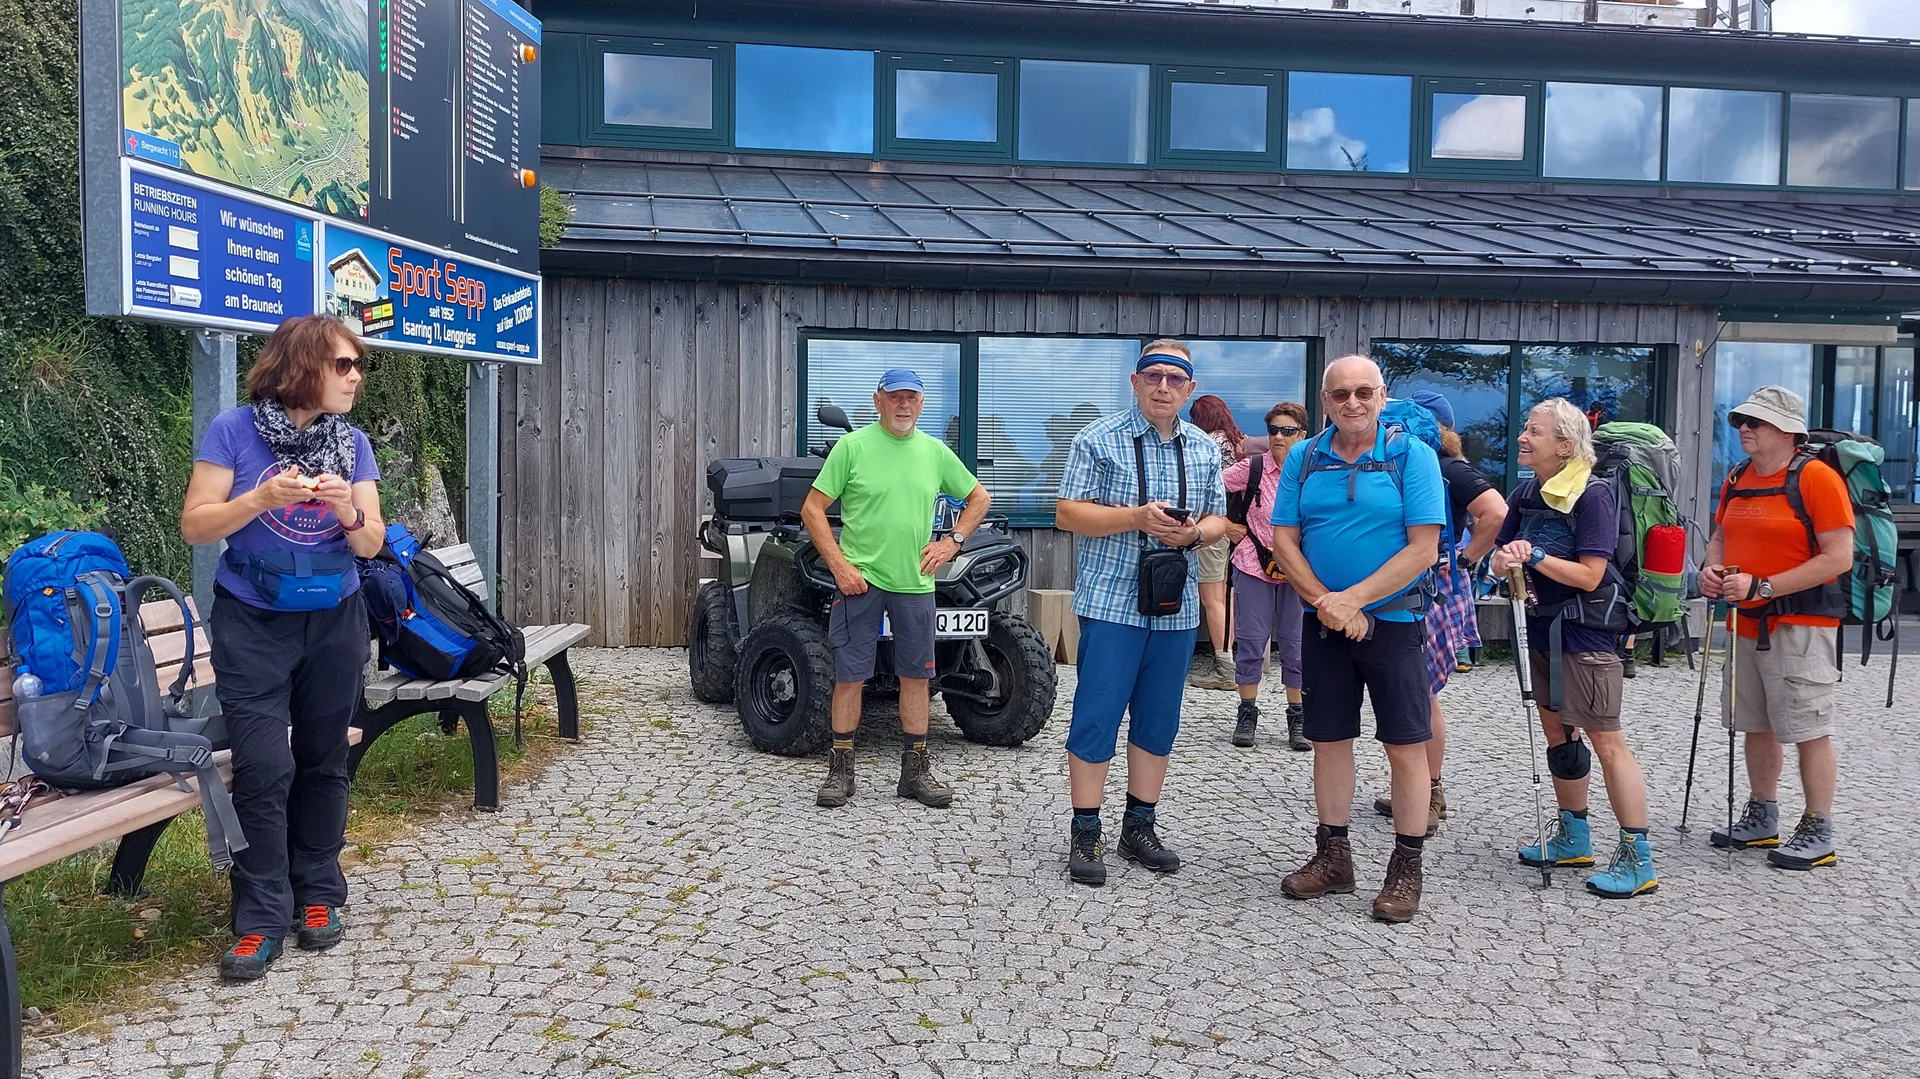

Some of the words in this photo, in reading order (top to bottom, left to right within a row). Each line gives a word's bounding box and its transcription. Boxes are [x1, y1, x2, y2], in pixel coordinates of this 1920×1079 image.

[141, 140, 168, 157] Bergwacht
[168, 149, 178, 159] 112
[134, 182, 197, 209] BETRIEBSZEITEN
[134, 198, 170, 218] RUNNING
[171, 207, 197, 224] HOURS
[220, 209, 238, 228] Wir
[238, 217, 284, 241] wünschen
[227, 238, 253, 258] Ihnen
[255, 249, 280, 265] einen
[225, 266, 266, 287] schönen
[266, 272, 282, 293] Tag
[388, 247, 441, 308] Sport
[444, 262, 486, 322] Sepp
[224, 294, 239, 309] am
[240, 296, 284, 316] Brauneck
[429, 306, 440, 318] seit
[440, 306, 455, 321] 1952
[493, 297, 503, 311] Das
[403, 317, 432, 345] Isarring
[433, 322, 442, 343] 11,
[443, 324, 477, 350] Lenggries
[496, 318, 504, 334] auf
[936, 613, 948, 633] Q
[952, 613, 987, 632] 120
